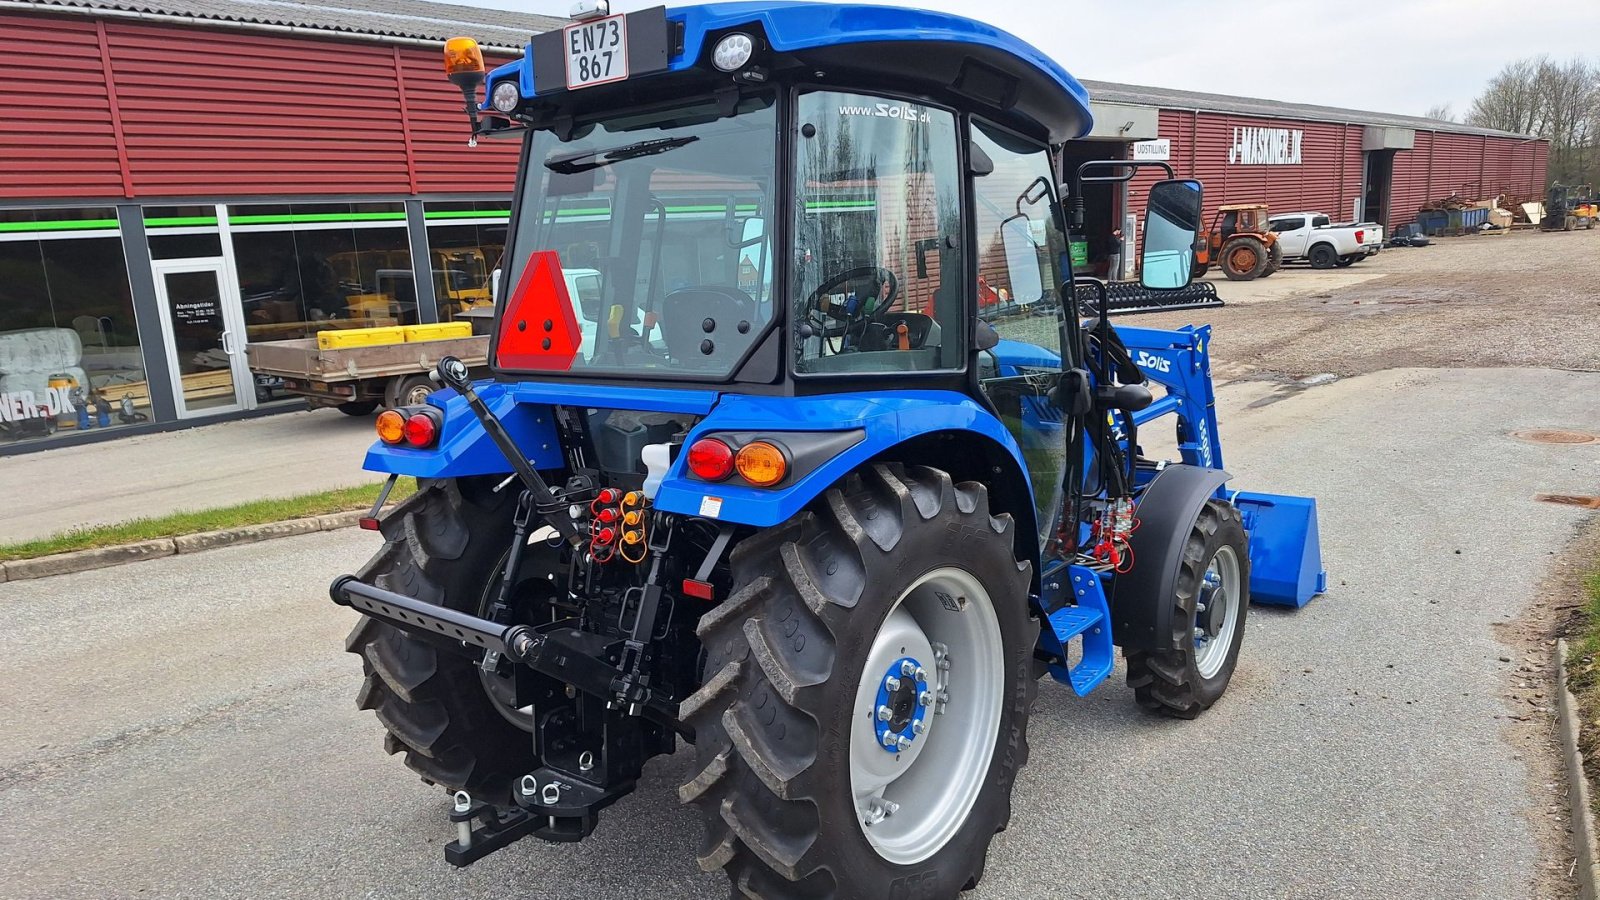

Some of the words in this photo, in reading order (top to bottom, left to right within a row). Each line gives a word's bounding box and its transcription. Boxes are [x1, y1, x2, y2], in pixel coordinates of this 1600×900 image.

[570, 20, 620, 55] EN73
[579, 50, 613, 82] 867
[1136, 144, 1168, 155] UDSTILLING
[1229, 126, 1304, 165] J-MASKINER.DK
